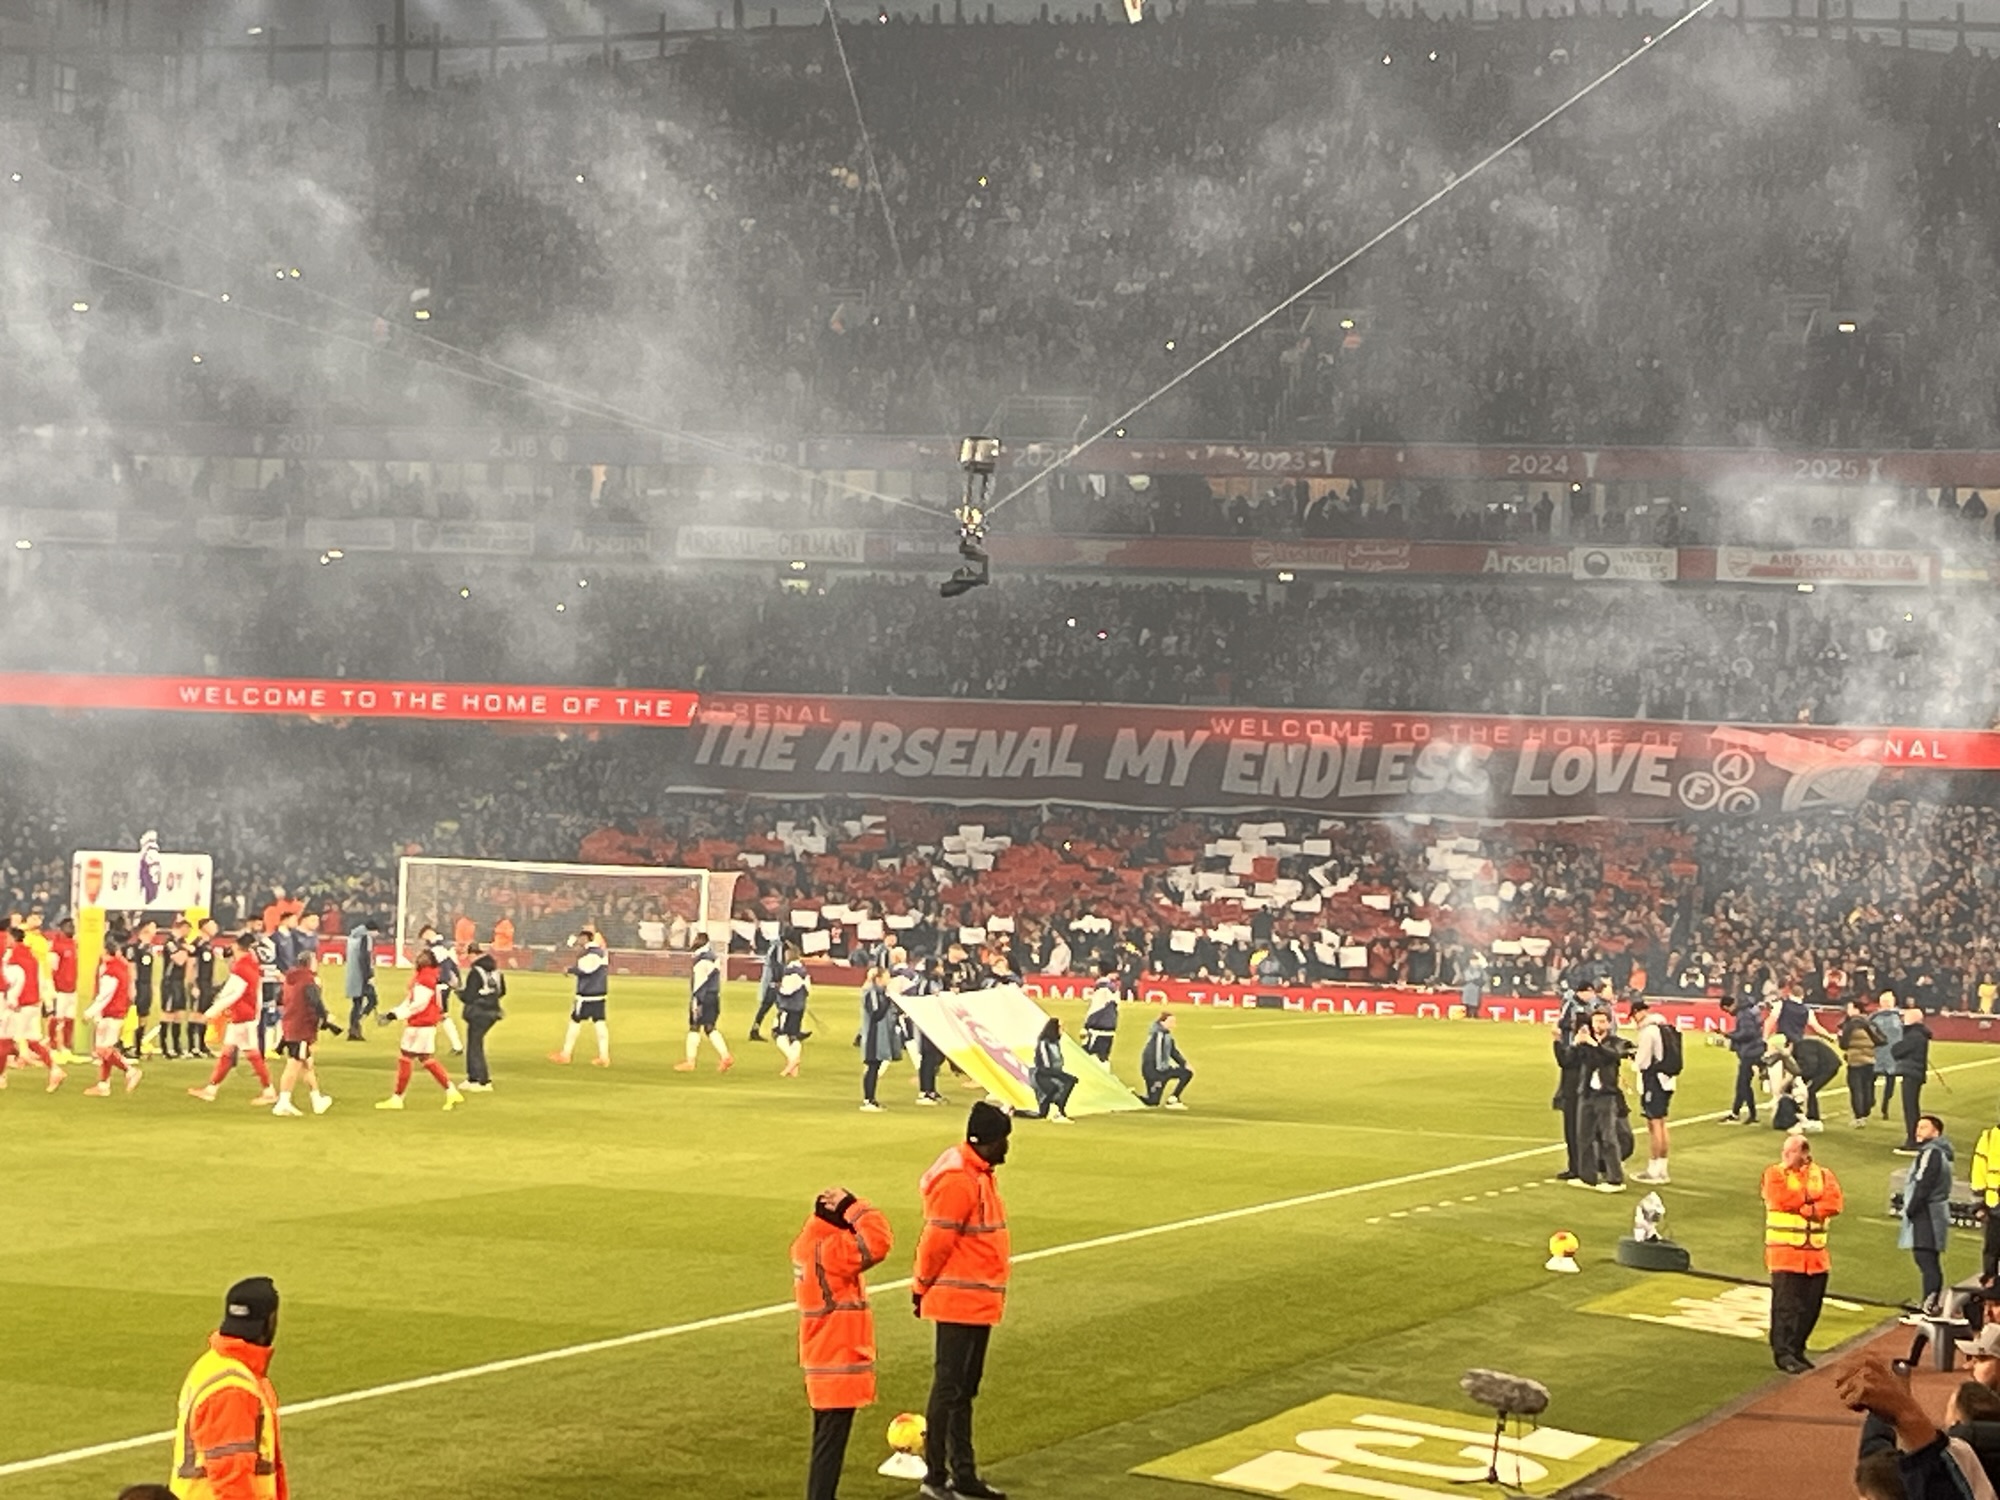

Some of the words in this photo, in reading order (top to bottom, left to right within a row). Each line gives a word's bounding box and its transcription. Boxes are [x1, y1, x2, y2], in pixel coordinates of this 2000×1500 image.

[1245, 451, 1306, 471] 2023
[1506, 454, 1570, 475] 2024
[1794, 458, 1860, 480] 2025
[1481, 550, 1571, 574] Arsenal
[178, 686, 326, 708] WELCOME
[341, 690, 377, 709] TO
[392, 690, 448, 711] THE
[462, 694, 547, 714] HOME
[562, 697, 600, 715] OF
[615, 698, 672, 718] THE
[1210, 717, 1374, 741] WELCOME
[1392, 722, 1431, 741] TO
[1449, 724, 1510, 744] THE
[1528, 726, 1625, 748] HOME
[694, 710, 806, 772] THE
[814, 720, 1083, 778] ARSENAL
[1104, 727, 1211, 787] MY
[1221, 733, 1494, 799] ENDLESS
[1511, 737, 1678, 798] LOVE
[1188, 992, 1257, 1008] THE
[1283, 996, 1396, 1015] HOME
